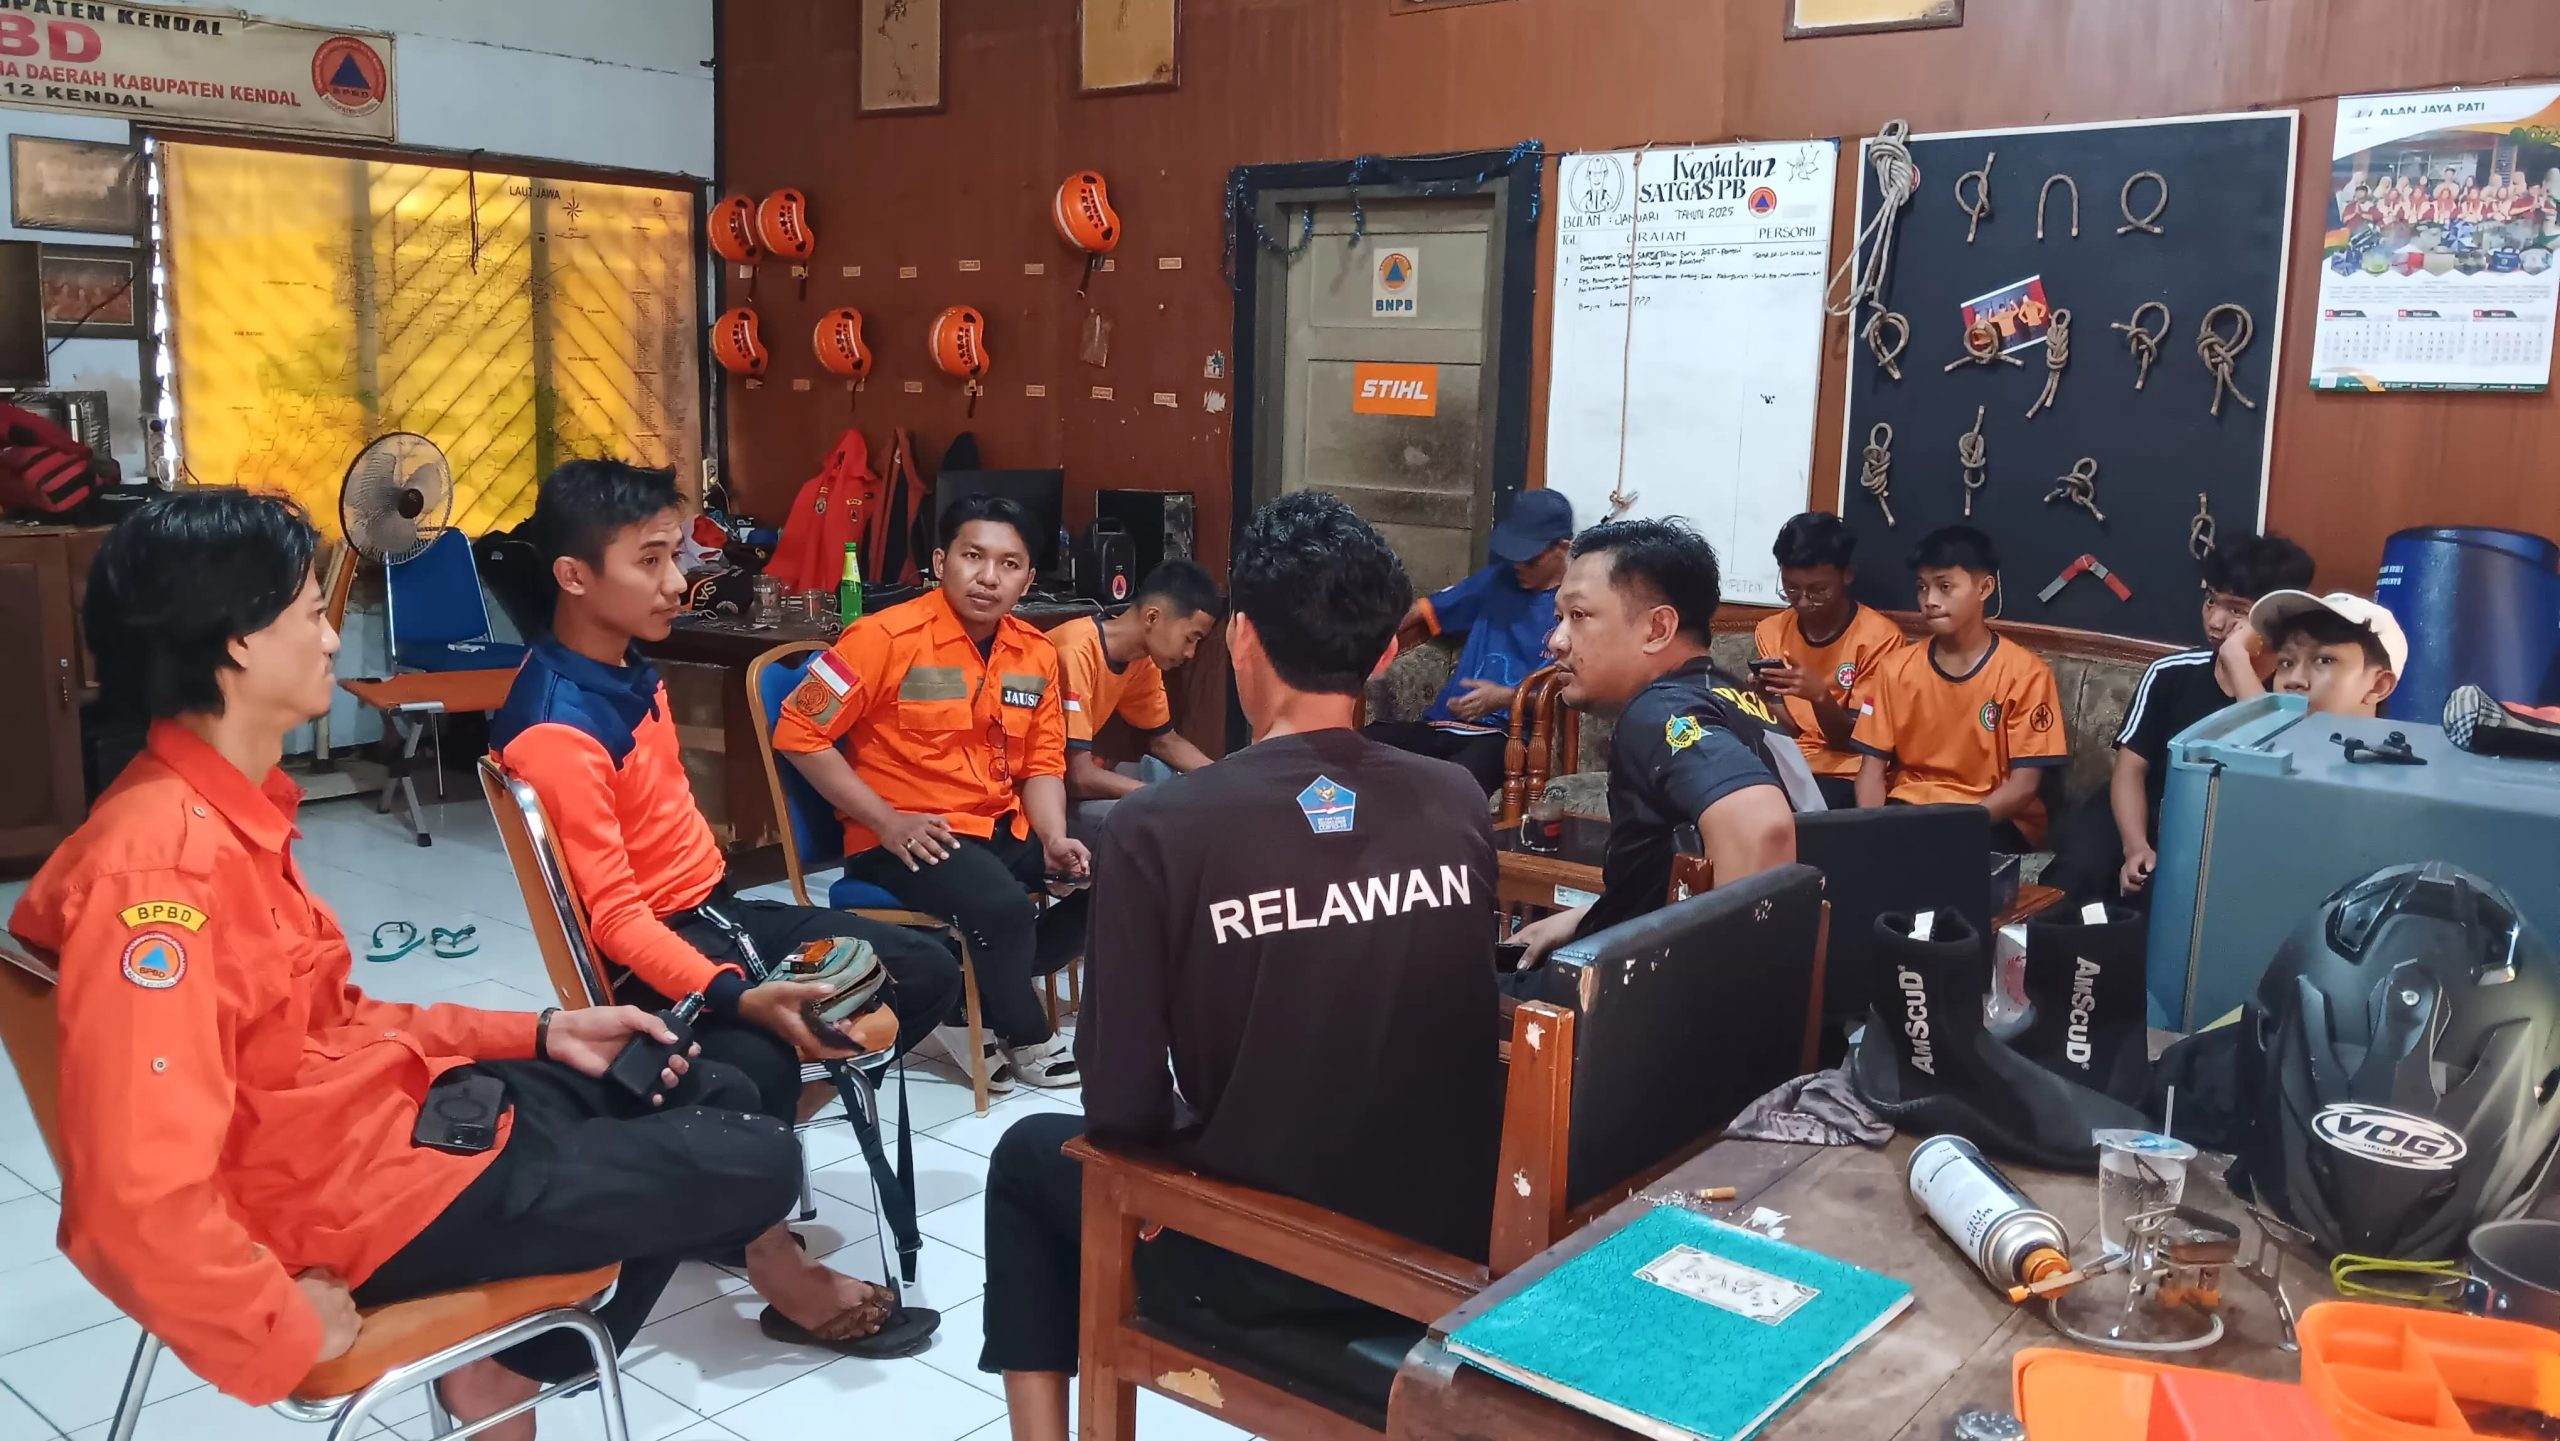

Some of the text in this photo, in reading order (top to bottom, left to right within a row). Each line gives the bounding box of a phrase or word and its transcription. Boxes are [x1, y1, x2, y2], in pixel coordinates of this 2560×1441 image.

[0, 0, 223, 36] PATEN KENDAL
[26, 63, 106, 87] DAERAH
[113, 73, 225, 99] KABUPATEN
[230, 86, 302, 108] KENDAL
[46, 86, 154, 108] KENDAL
[2380, 102, 2485, 116] ALAN JAYA PATI
[536, 187, 561, 200] JAWA
[1638, 178, 1746, 203] SATGAS PB
[1563, 214, 1601, 229] BULAN
[1708, 206, 1735, 218] 2025
[1375, 299, 1413, 312] BNPB
[1361, 379, 1429, 401] STIHL
[137, 905, 192, 923] BPBD
[1208, 864, 1472, 945] RELAWAN
[2337, 1114, 2443, 1159] VOG
